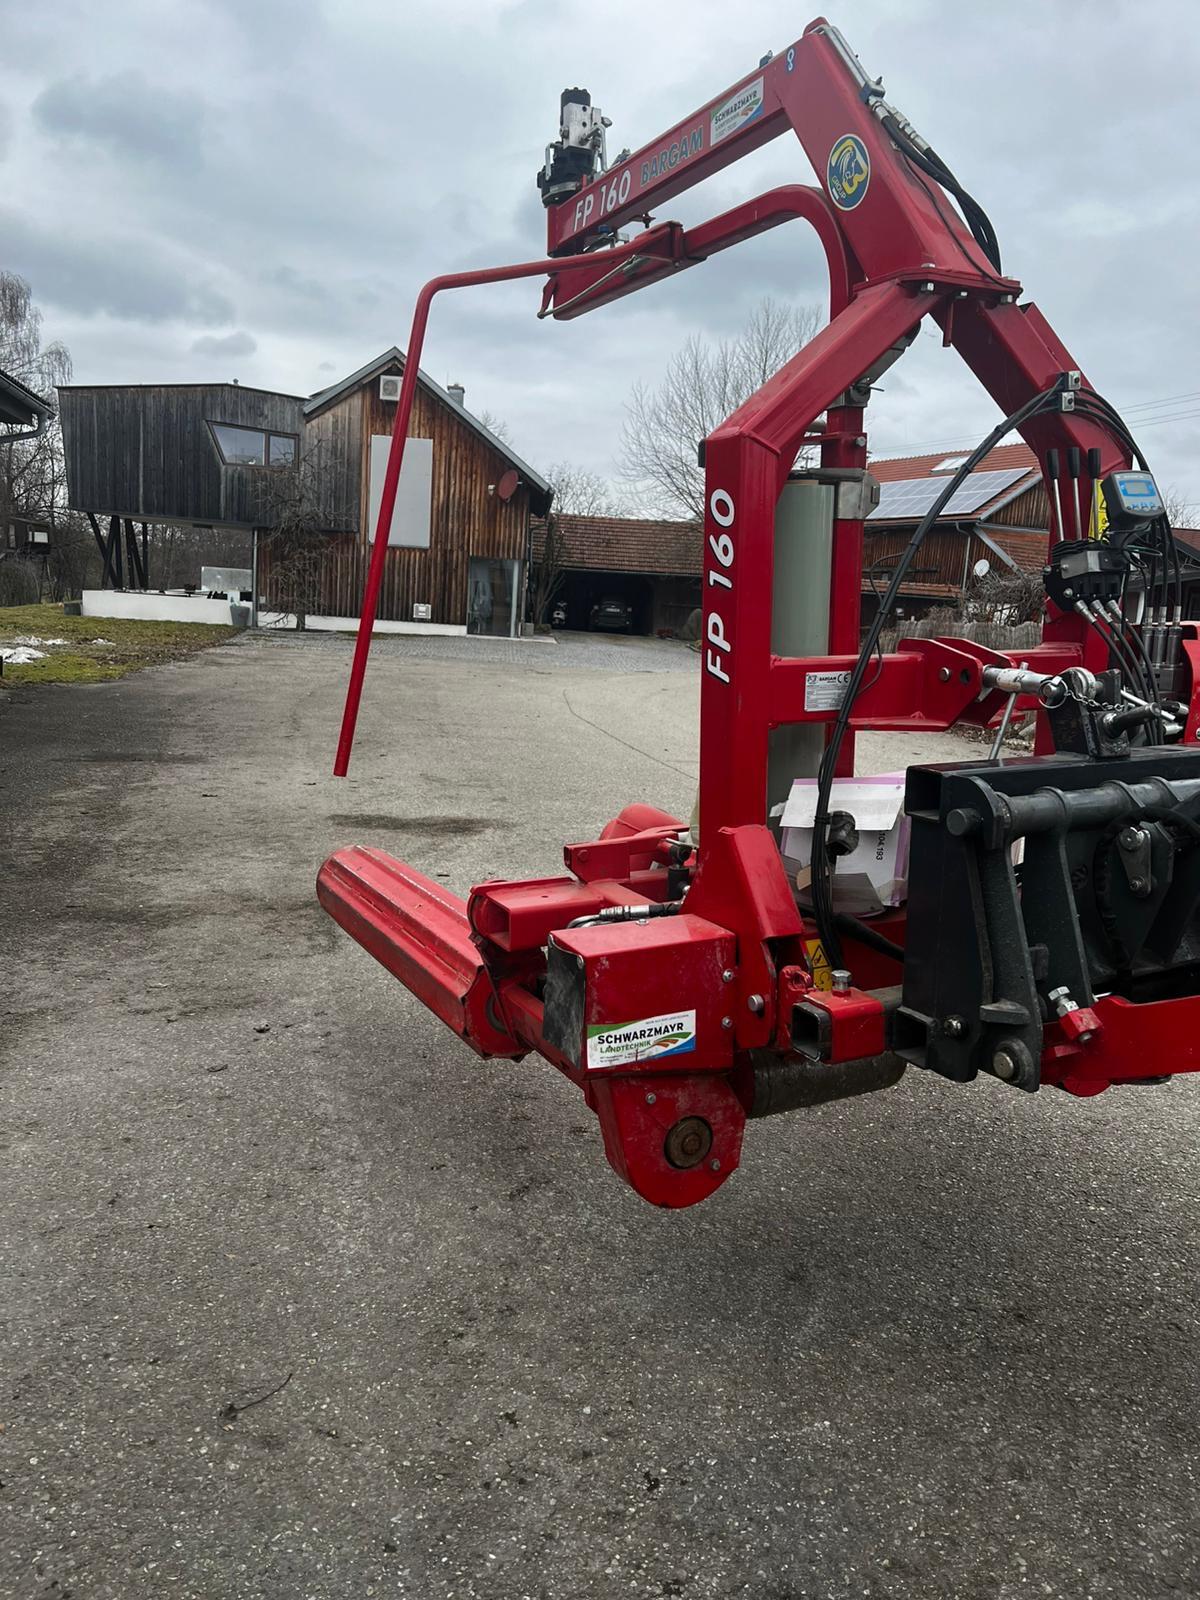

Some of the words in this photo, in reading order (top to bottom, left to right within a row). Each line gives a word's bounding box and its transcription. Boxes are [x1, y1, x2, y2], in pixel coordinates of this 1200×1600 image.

[573, 193, 594, 233] FP
[600, 169, 632, 217] 160
[640, 124, 704, 188] BARGAM
[831, 175, 847, 199] GROUP
[708, 488, 735, 589] 160
[707, 611, 732, 684] FP
[875, 847, 884, 861] 193
[597, 1022, 684, 1045] SCHWARZMAYR
[600, 1040, 651, 1054] LANDTECHNIK
